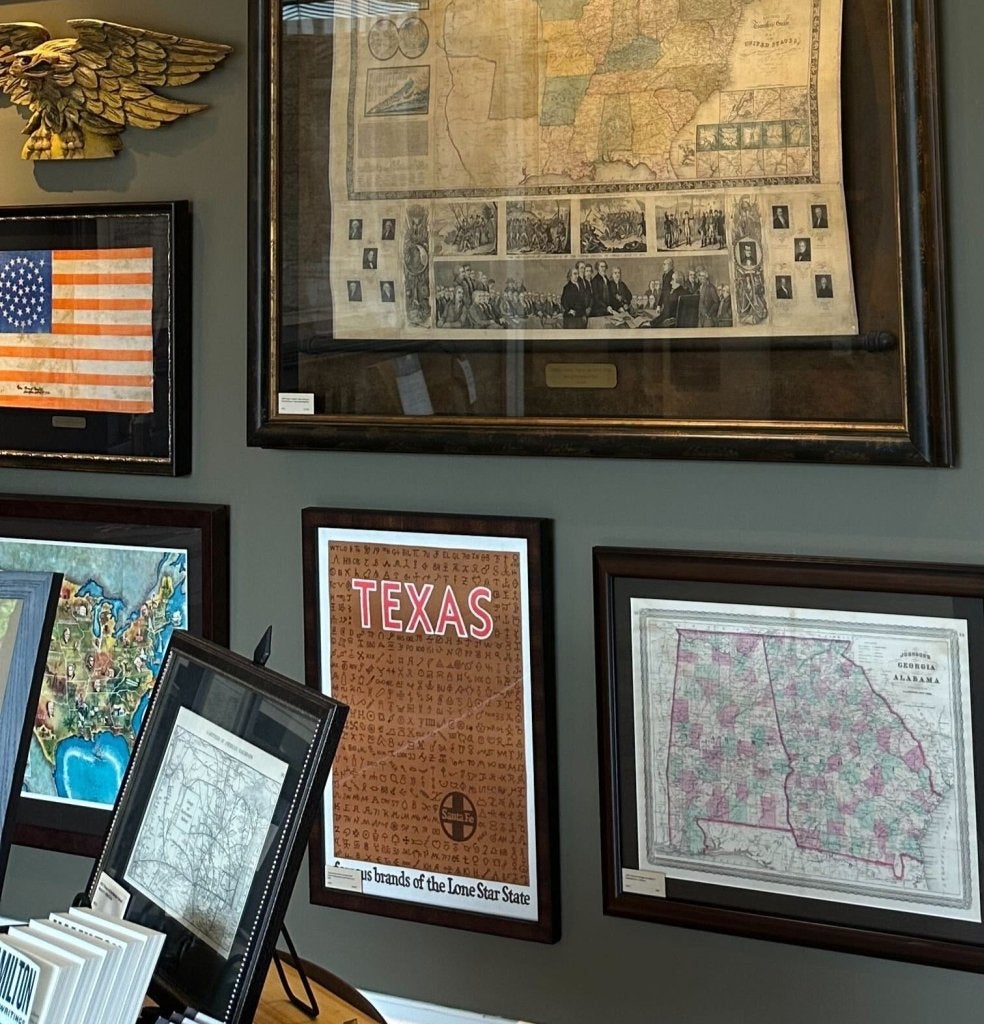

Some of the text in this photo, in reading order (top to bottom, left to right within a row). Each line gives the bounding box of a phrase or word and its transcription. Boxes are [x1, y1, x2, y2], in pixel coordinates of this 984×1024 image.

[351, 578, 494, 640] TEXAS
[893, 674, 940, 684] ALABAMA
[897, 662, 936, 671] GEORGIA
[373, 866, 411, 888] brands
[413, 875, 425, 890] of
[427, 877, 445, 894] the
[448, 877, 475, 898] Lone
[477, 881, 500, 901] Star
[502, 886, 530, 906] State
